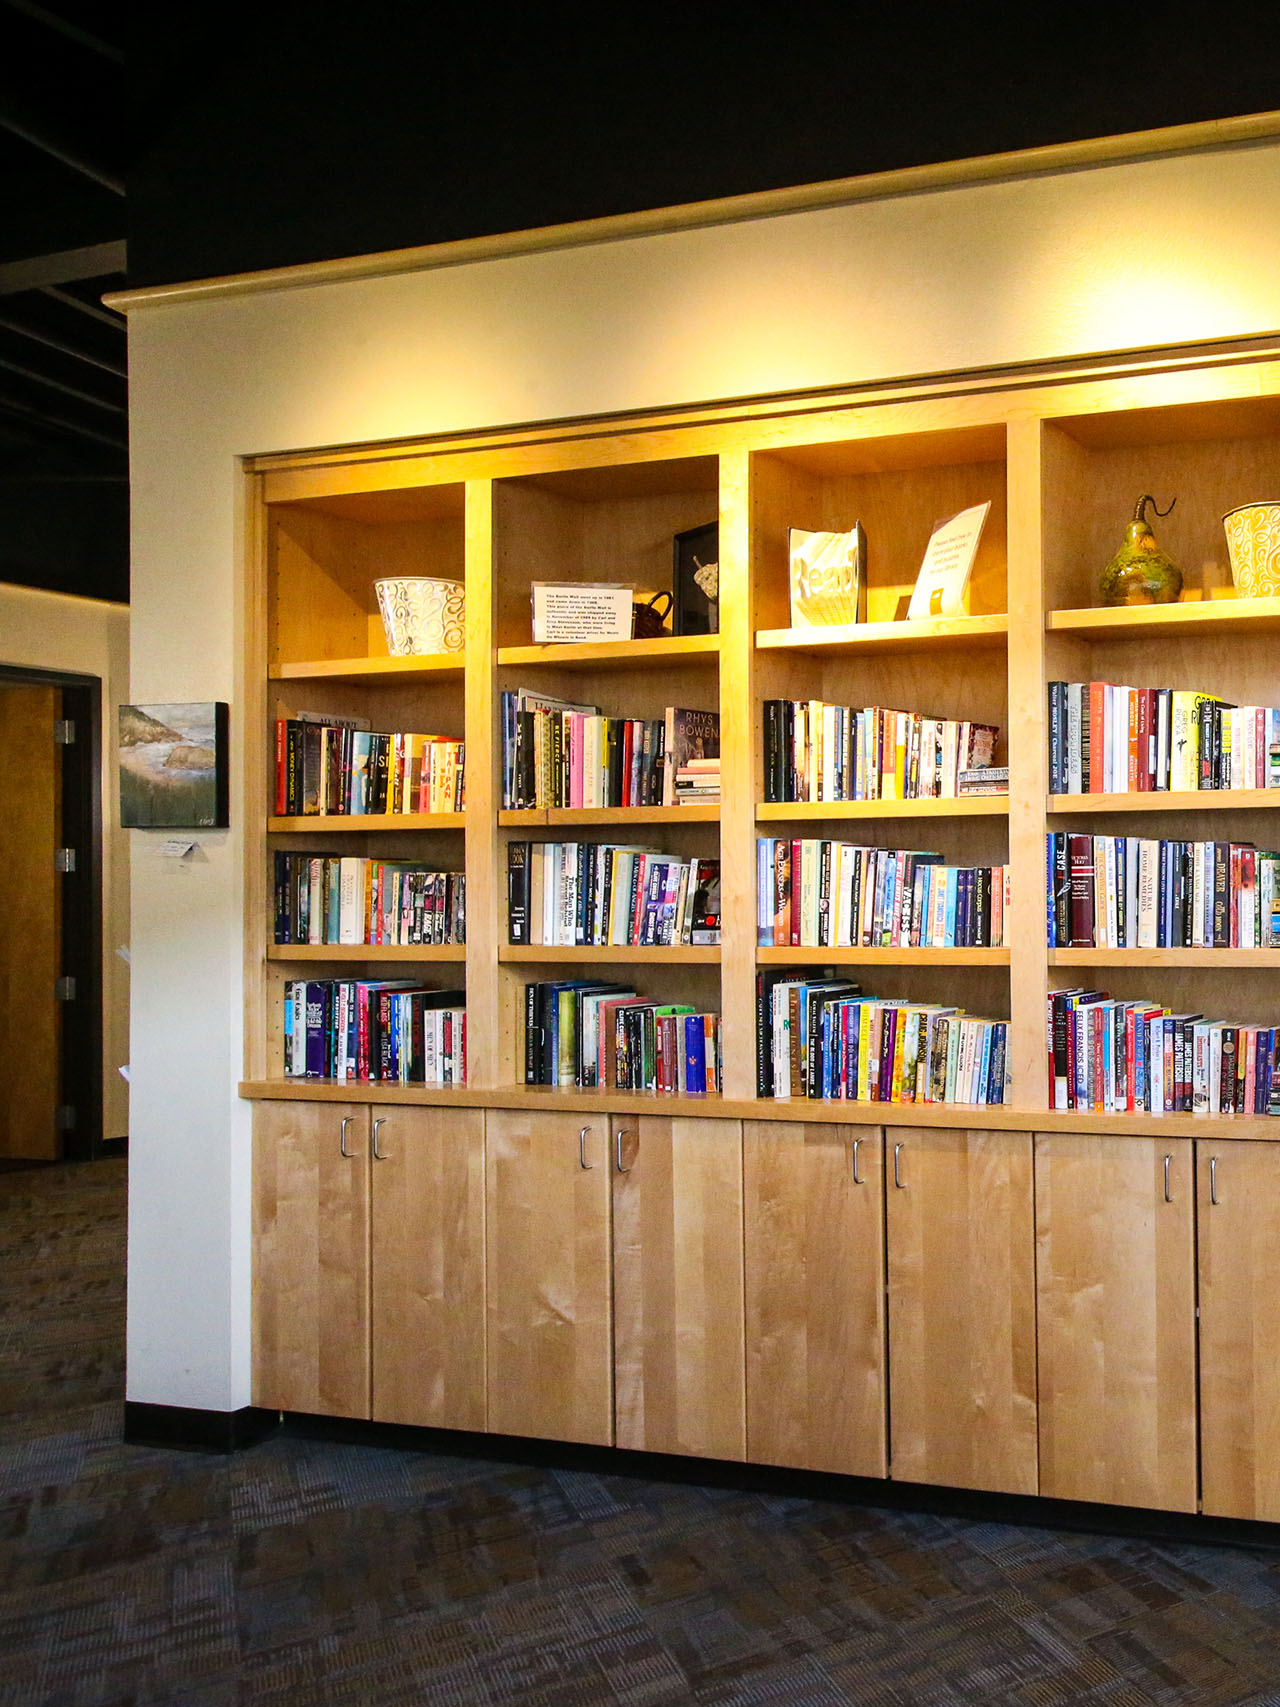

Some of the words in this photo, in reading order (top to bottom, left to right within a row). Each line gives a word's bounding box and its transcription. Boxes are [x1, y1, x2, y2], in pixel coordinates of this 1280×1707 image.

[686, 711, 713, 725] RHYS
[679, 724, 718, 738] BOWEN
[1056, 849, 1066, 870] CASE
[1216, 863, 1225, 892] DEAVER
[778, 899, 786, 926] Women
[380, 1007, 388, 1022] FLAGS
[918, 1033, 927, 1063] JOHNSON
[1175, 1033, 1184, 1051] JAMES
[1175, 1052, 1184, 1083] PATTERSON
[1184, 1057, 1192, 1083] PATTERSON
